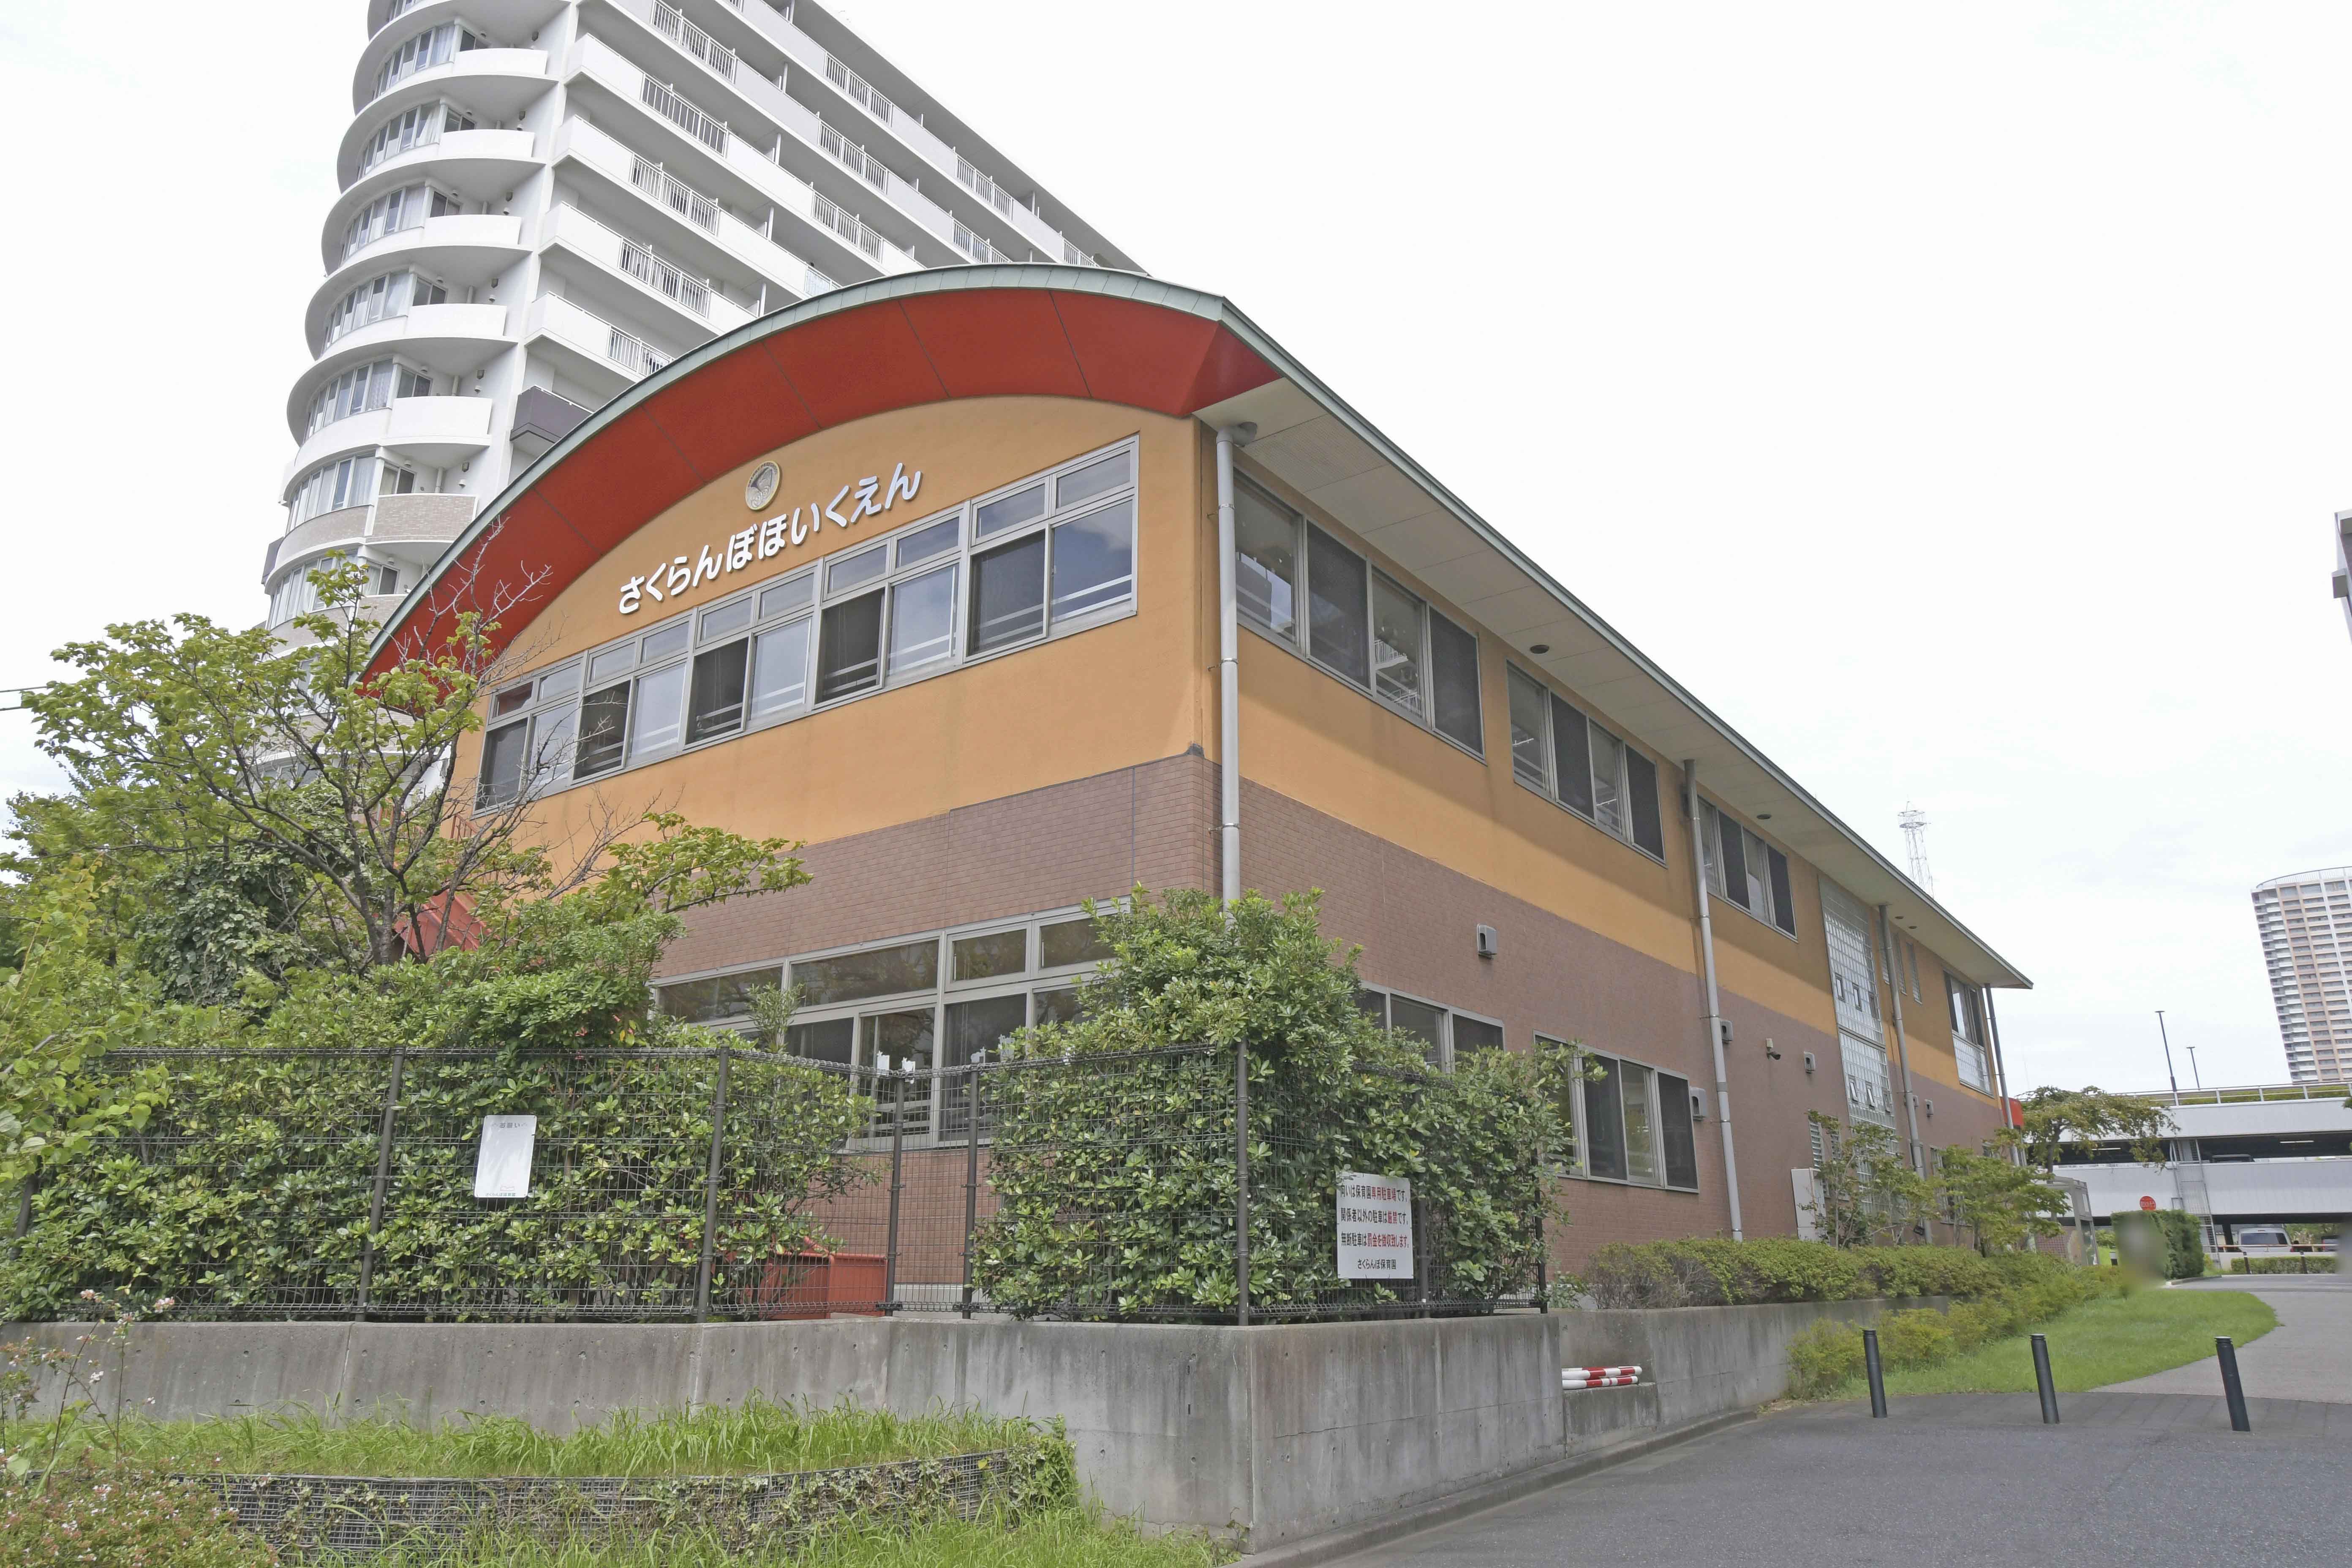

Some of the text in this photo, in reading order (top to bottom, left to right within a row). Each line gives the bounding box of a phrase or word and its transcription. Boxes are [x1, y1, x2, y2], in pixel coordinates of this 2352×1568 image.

[619, 463, 922, 614] さくらんぼほいくえん
[1341, 1207, 1408, 1225] 関係者以外の駐車は厳禁です。
[1357, 1258, 1396, 1269] さくらんぼ保育園
